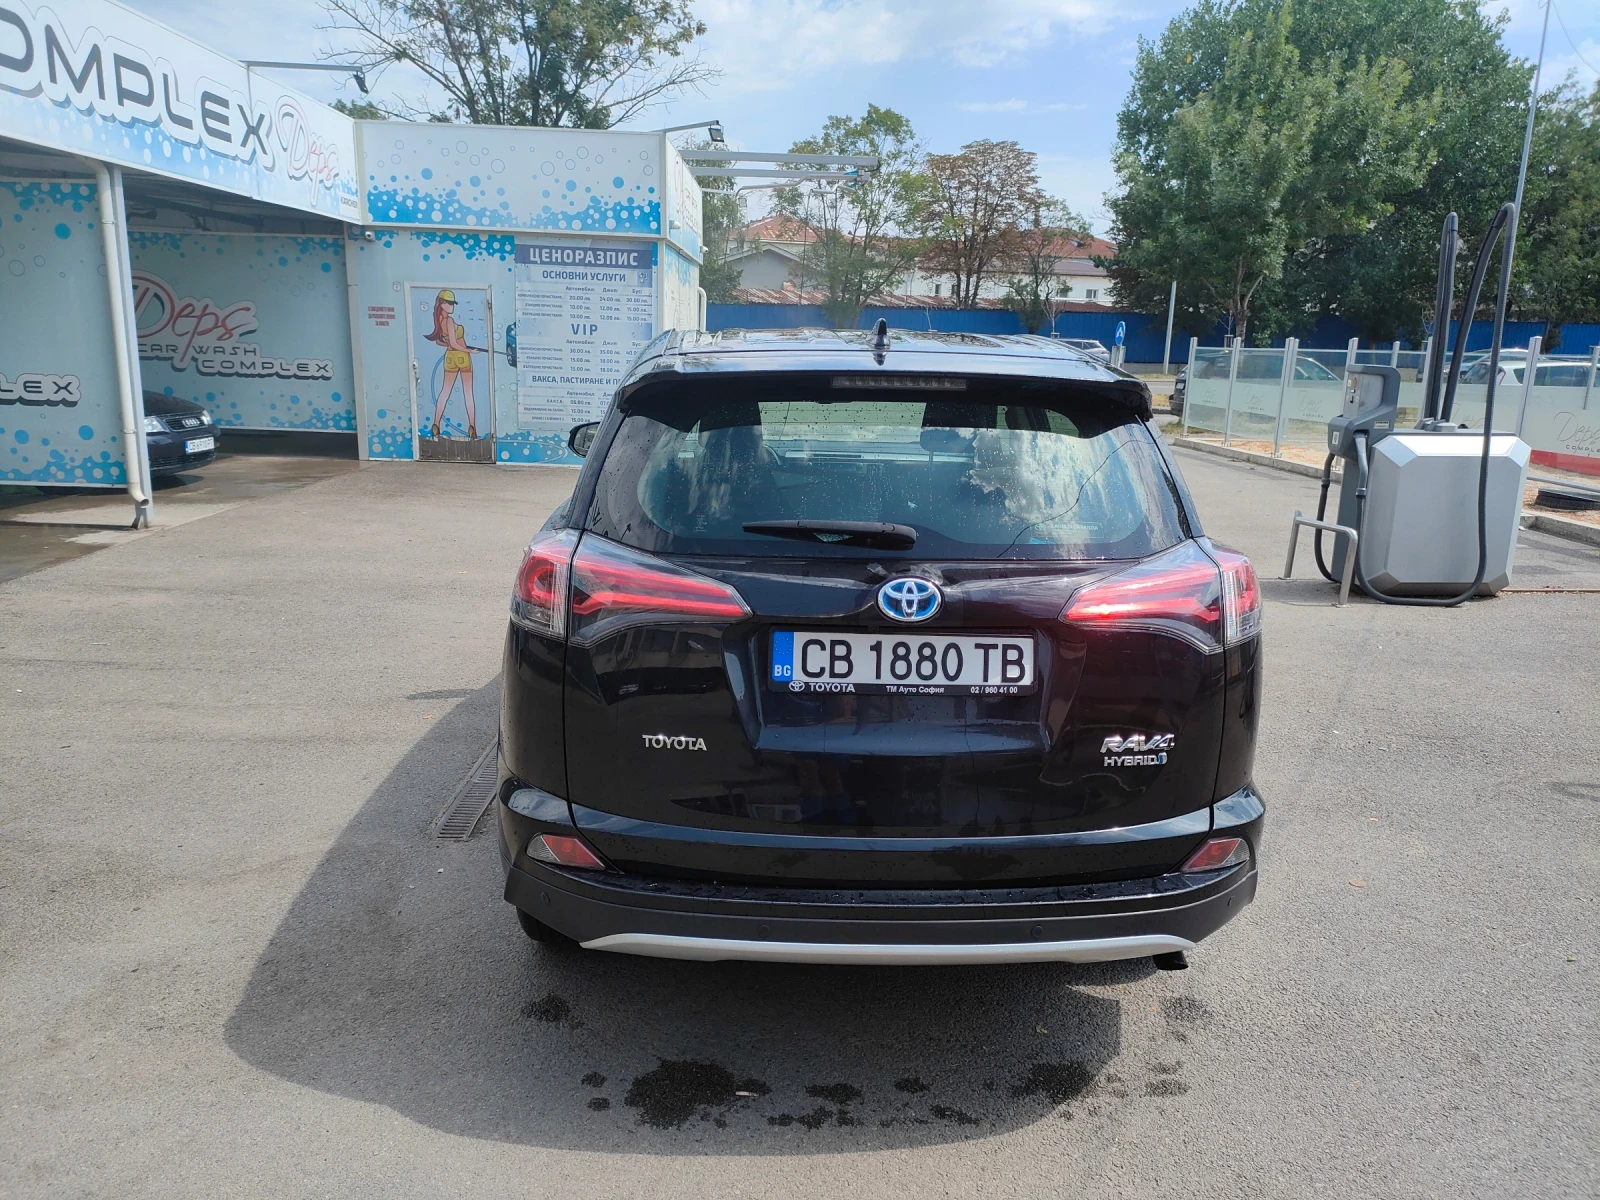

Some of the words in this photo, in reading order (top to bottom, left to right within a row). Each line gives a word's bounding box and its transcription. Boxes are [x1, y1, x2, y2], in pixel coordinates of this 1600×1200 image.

[277, 103, 337, 200] Deps
[529, 248, 639, 266] ЦЕНОРАЗПИС
[542, 270, 588, 281] ОСНОВНИ
[589, 271, 626, 282] УСЛУГИ
[131, 275, 252, 362] Deps
[571, 323, 598, 336] VIP
[192, 345, 257, 356] WASH
[202, 360, 328, 373] COMPLEX
[532, 375, 559, 385] ВАКСА,
[560, 376, 604, 386] ПАСТИРАНЕ
[801, 638, 854, 679] CB
[869, 640, 964, 682] 1880
[974, 642, 1026, 684] TB
[774, 664, 792, 677] BG
[808, 683, 856, 693] TOYOTA
[898, 685, 917, 694] Ауто
[918, 685, 945, 694] София
[970, 686, 980, 694] 02
[999, 686, 1008, 694] 41
[1009, 686, 1018, 694] 00
[641, 734, 708, 752] TOYOTA
[1100, 734, 1175, 753] RAV4
[1103, 755, 1158, 767] HYBRID
